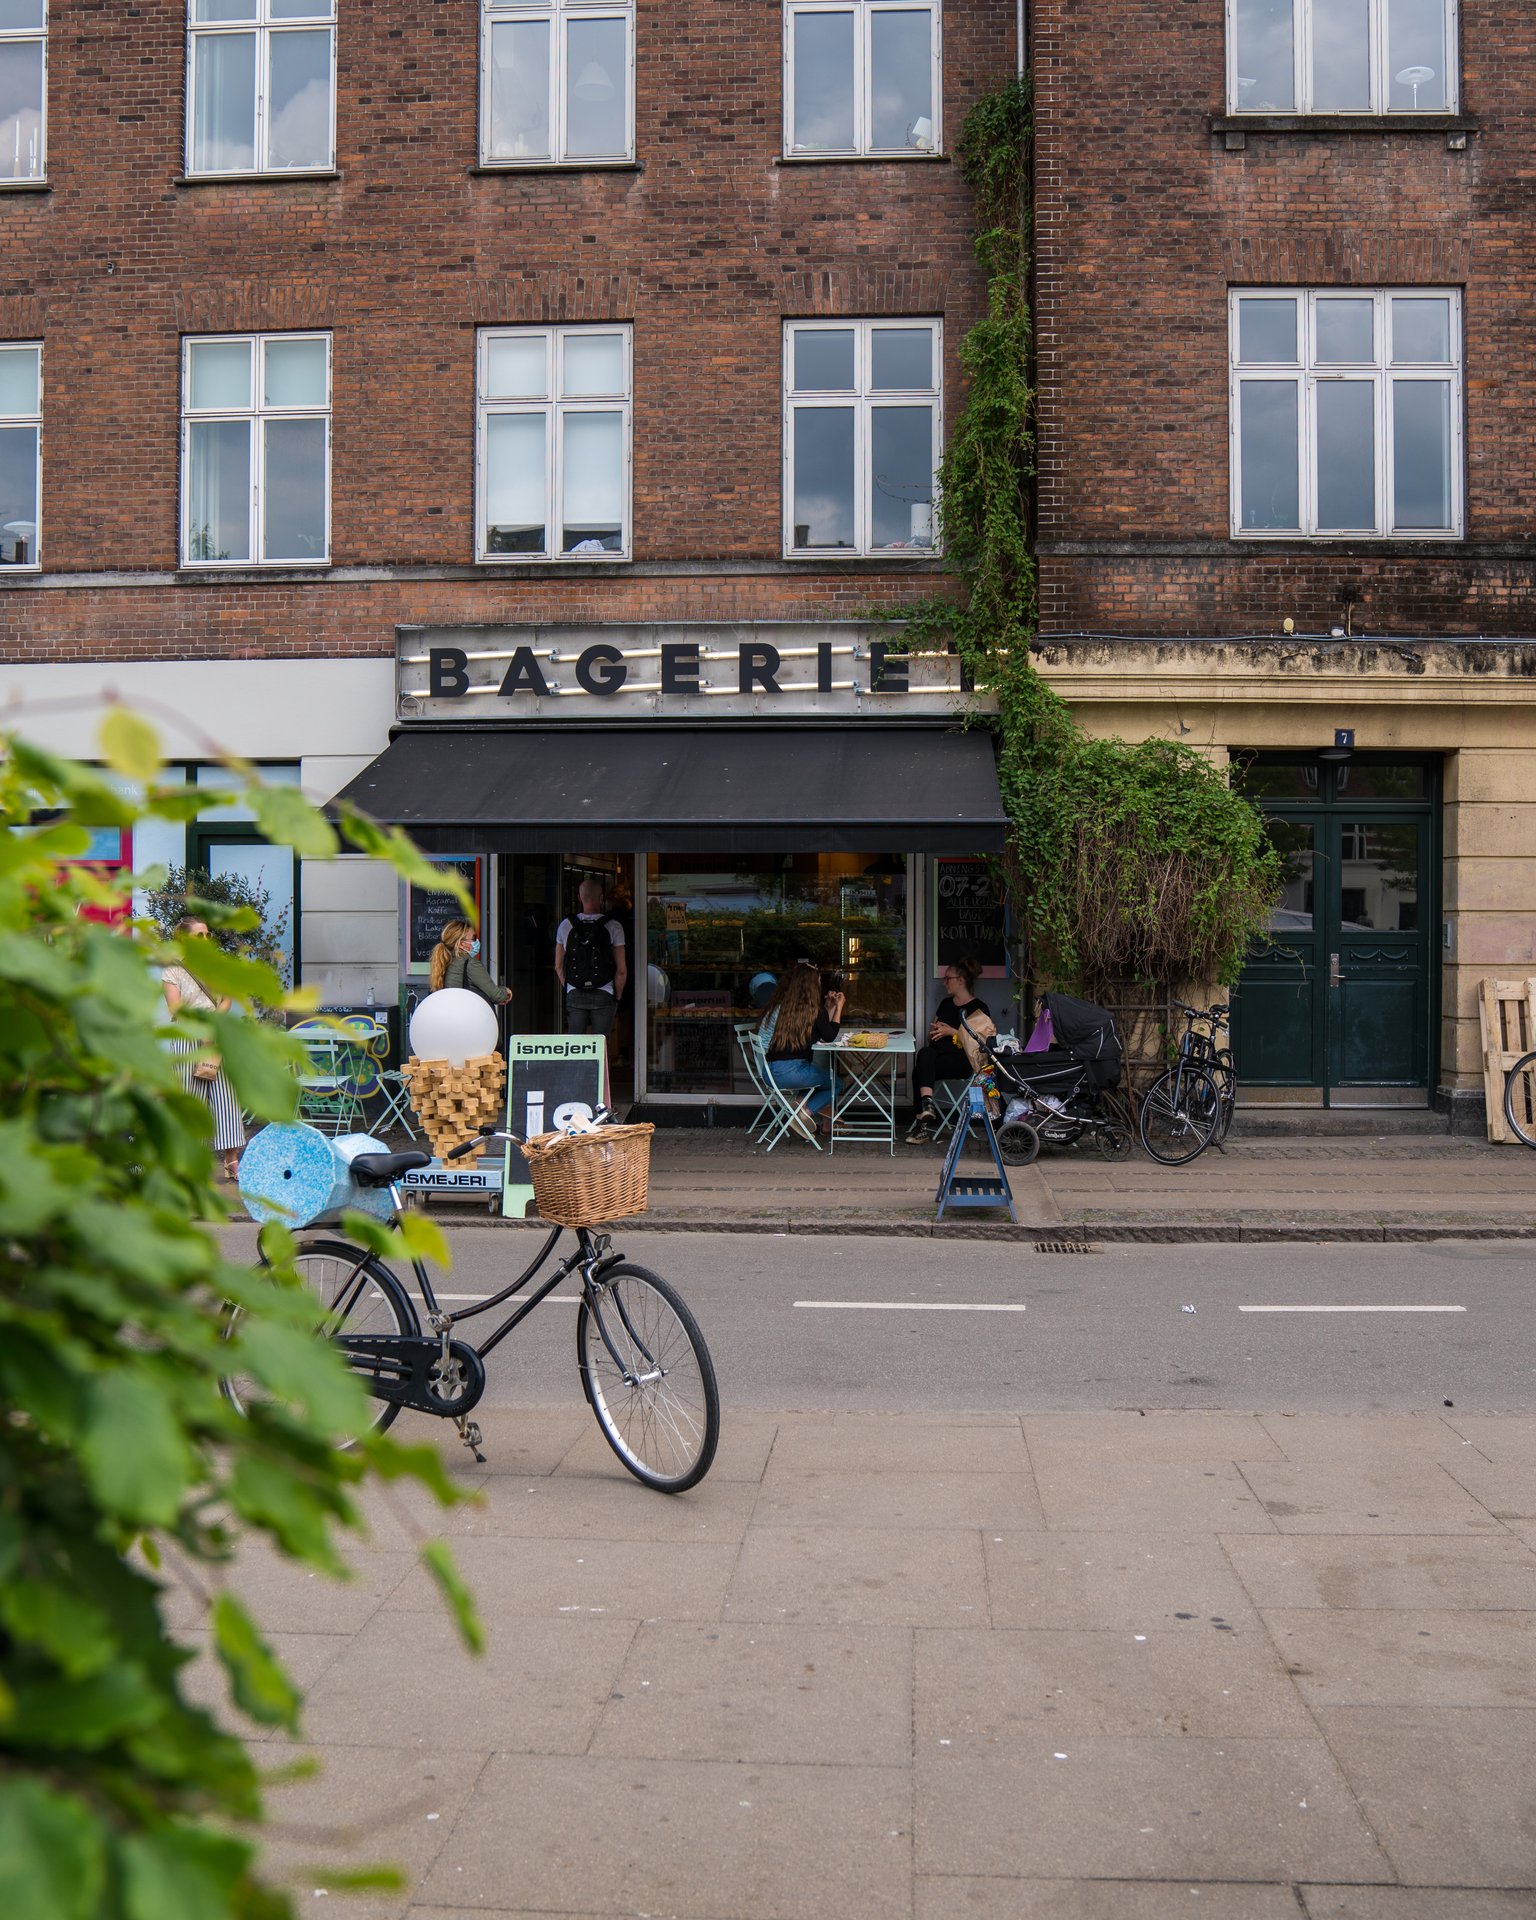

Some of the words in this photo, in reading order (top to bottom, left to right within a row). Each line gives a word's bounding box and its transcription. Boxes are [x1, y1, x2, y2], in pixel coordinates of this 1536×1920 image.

[1341, 732, 1348, 744] 7
[939, 875, 992, 897] 07-2
[517, 1042, 597, 1056] ismejeri
[403, 1173, 487, 1187] ISMEJERI
